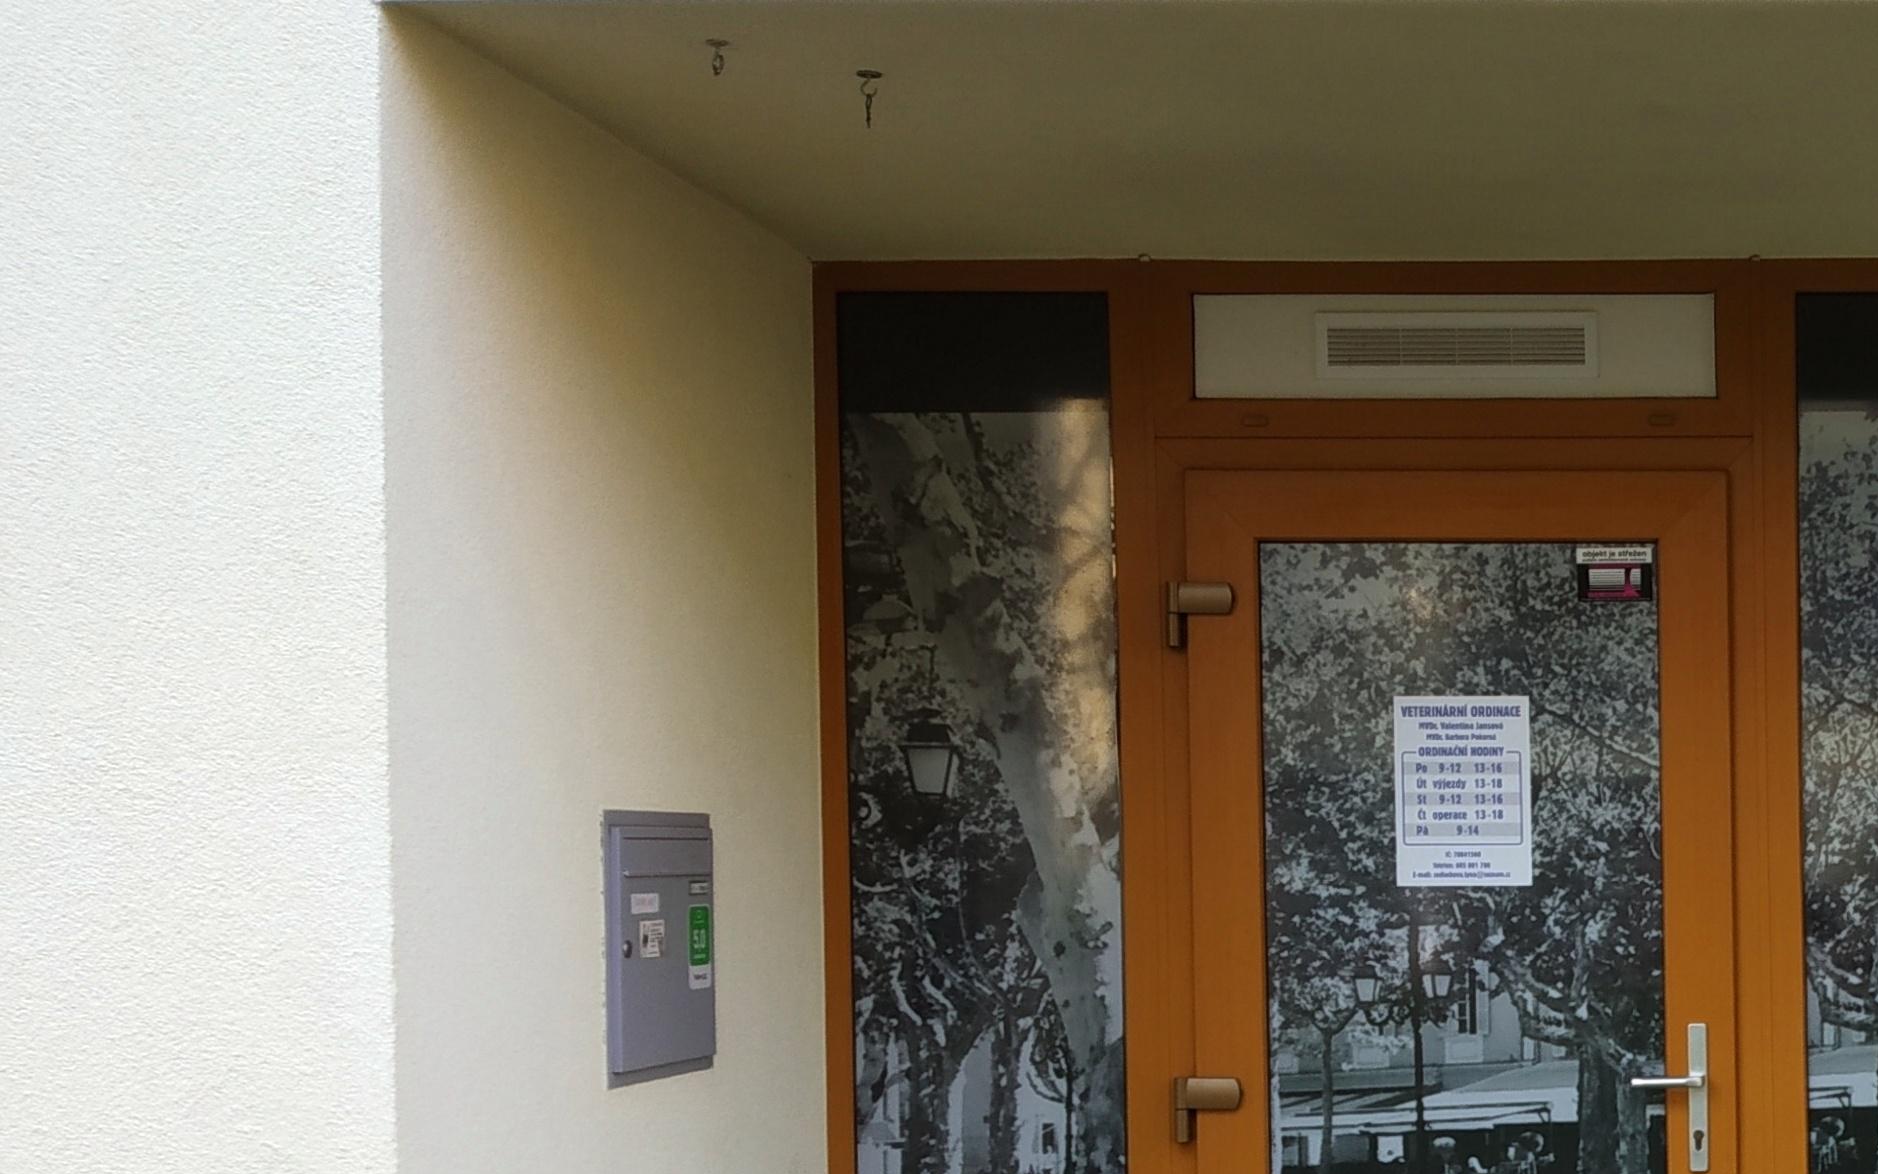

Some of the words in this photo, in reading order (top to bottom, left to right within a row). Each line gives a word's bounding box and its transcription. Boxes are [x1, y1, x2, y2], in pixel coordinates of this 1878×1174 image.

[1582, 550, 1607, 559] objekt
[1609, 550, 1616, 559] je
[1401, 704, 1467, 717] VETERINÁRNÍ
[1471, 705, 1521, 717] ORDINACE
[1418, 744, 1467, 757] ORDINAČNÍ
[1470, 747, 1504, 757] HODINY
[1415, 763, 1428, 773] Po
[1416, 776, 1427, 789] Út
[1432, 779, 1466, 790] výjezdy
[1417, 794, 1427, 805] St
[1417, 807, 1427, 820] Čt
[1432, 811, 1467, 821] operace
[1416, 825, 1429, 836] Pá
